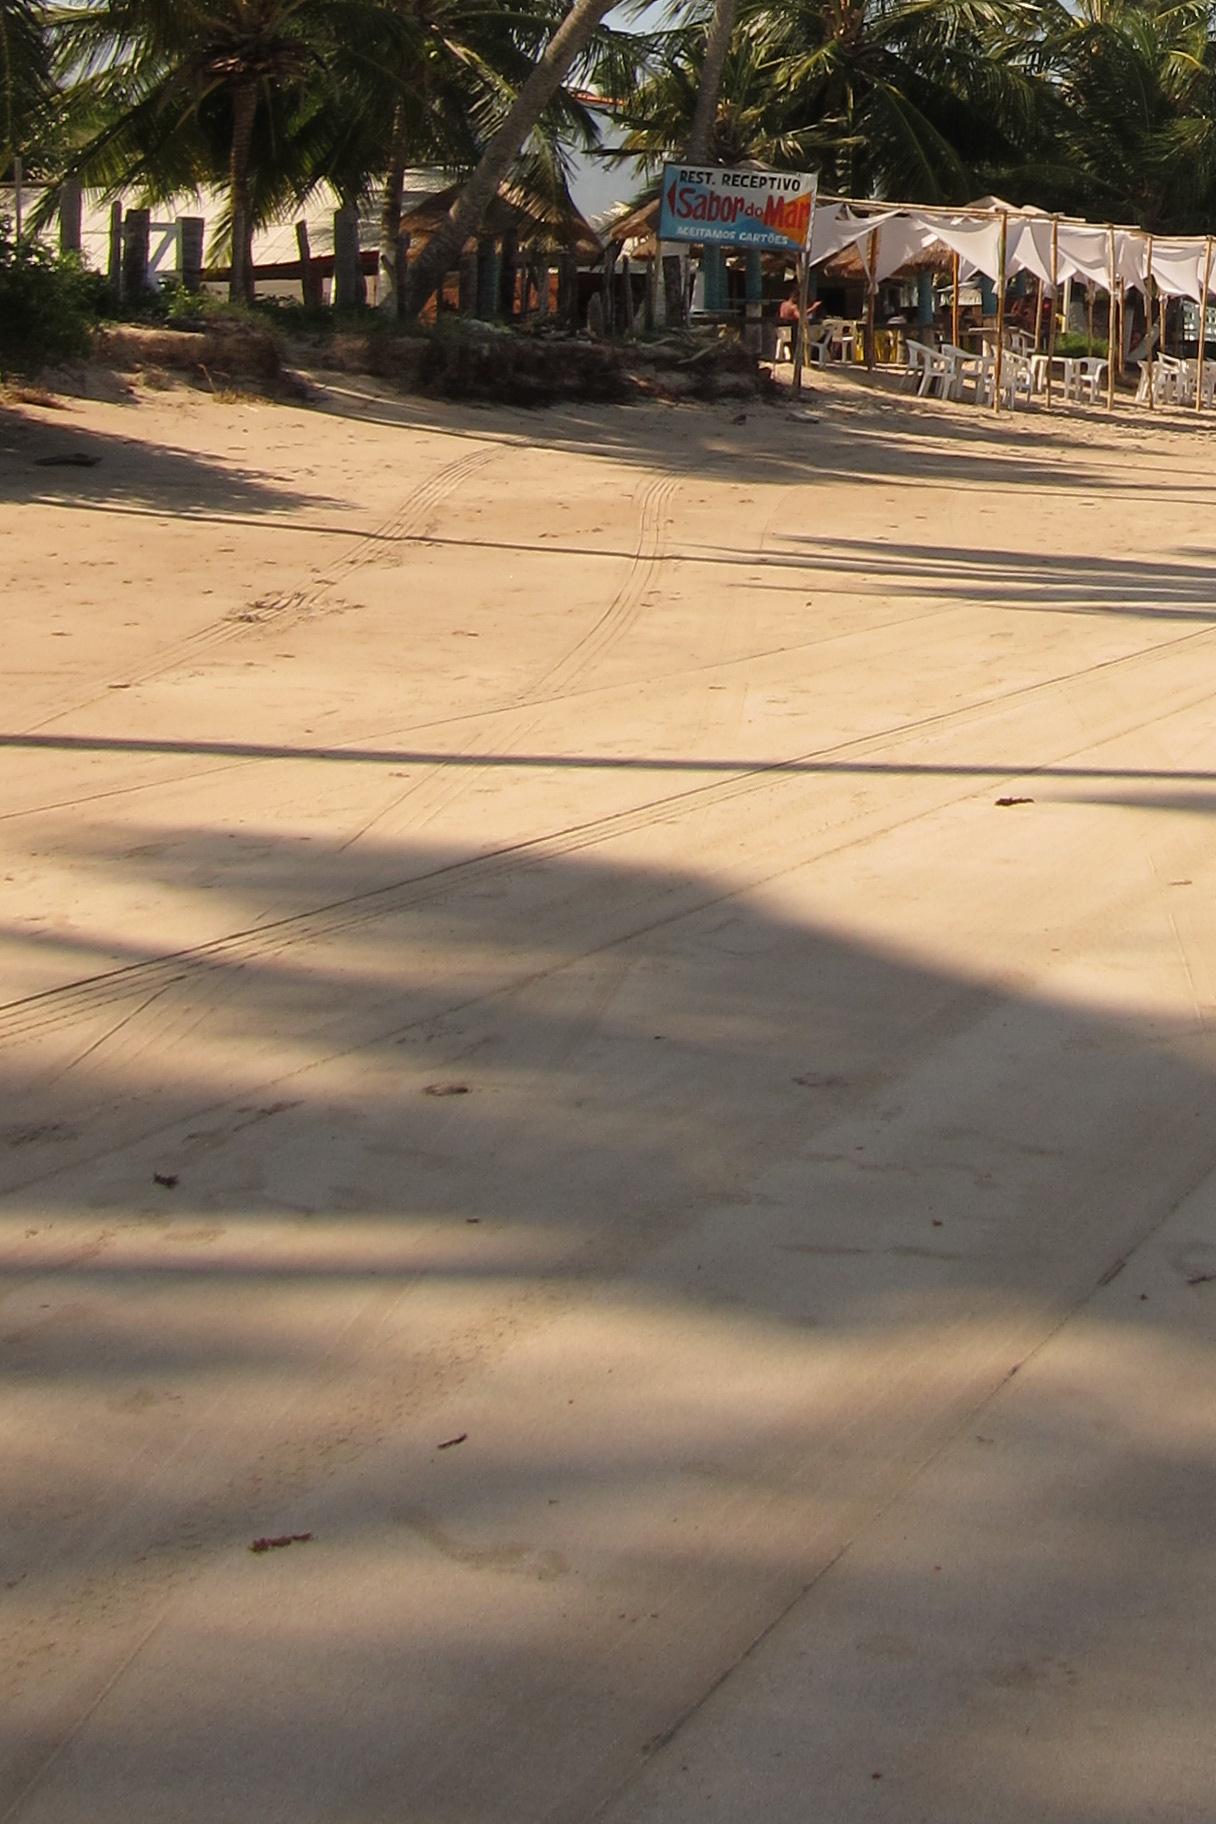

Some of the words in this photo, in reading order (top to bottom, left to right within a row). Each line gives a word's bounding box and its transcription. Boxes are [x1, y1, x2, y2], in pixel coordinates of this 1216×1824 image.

[680, 170, 715, 185] REST.
[721, 173, 801, 191] RECEPTIVO
[677, 187, 744, 223] Sabor
[745, 202, 763, 217] do
[763, 195, 811, 228] Mar
[676, 226, 736, 239] ACEITAMOS
[739, 232, 788, 245] CARTÕES
